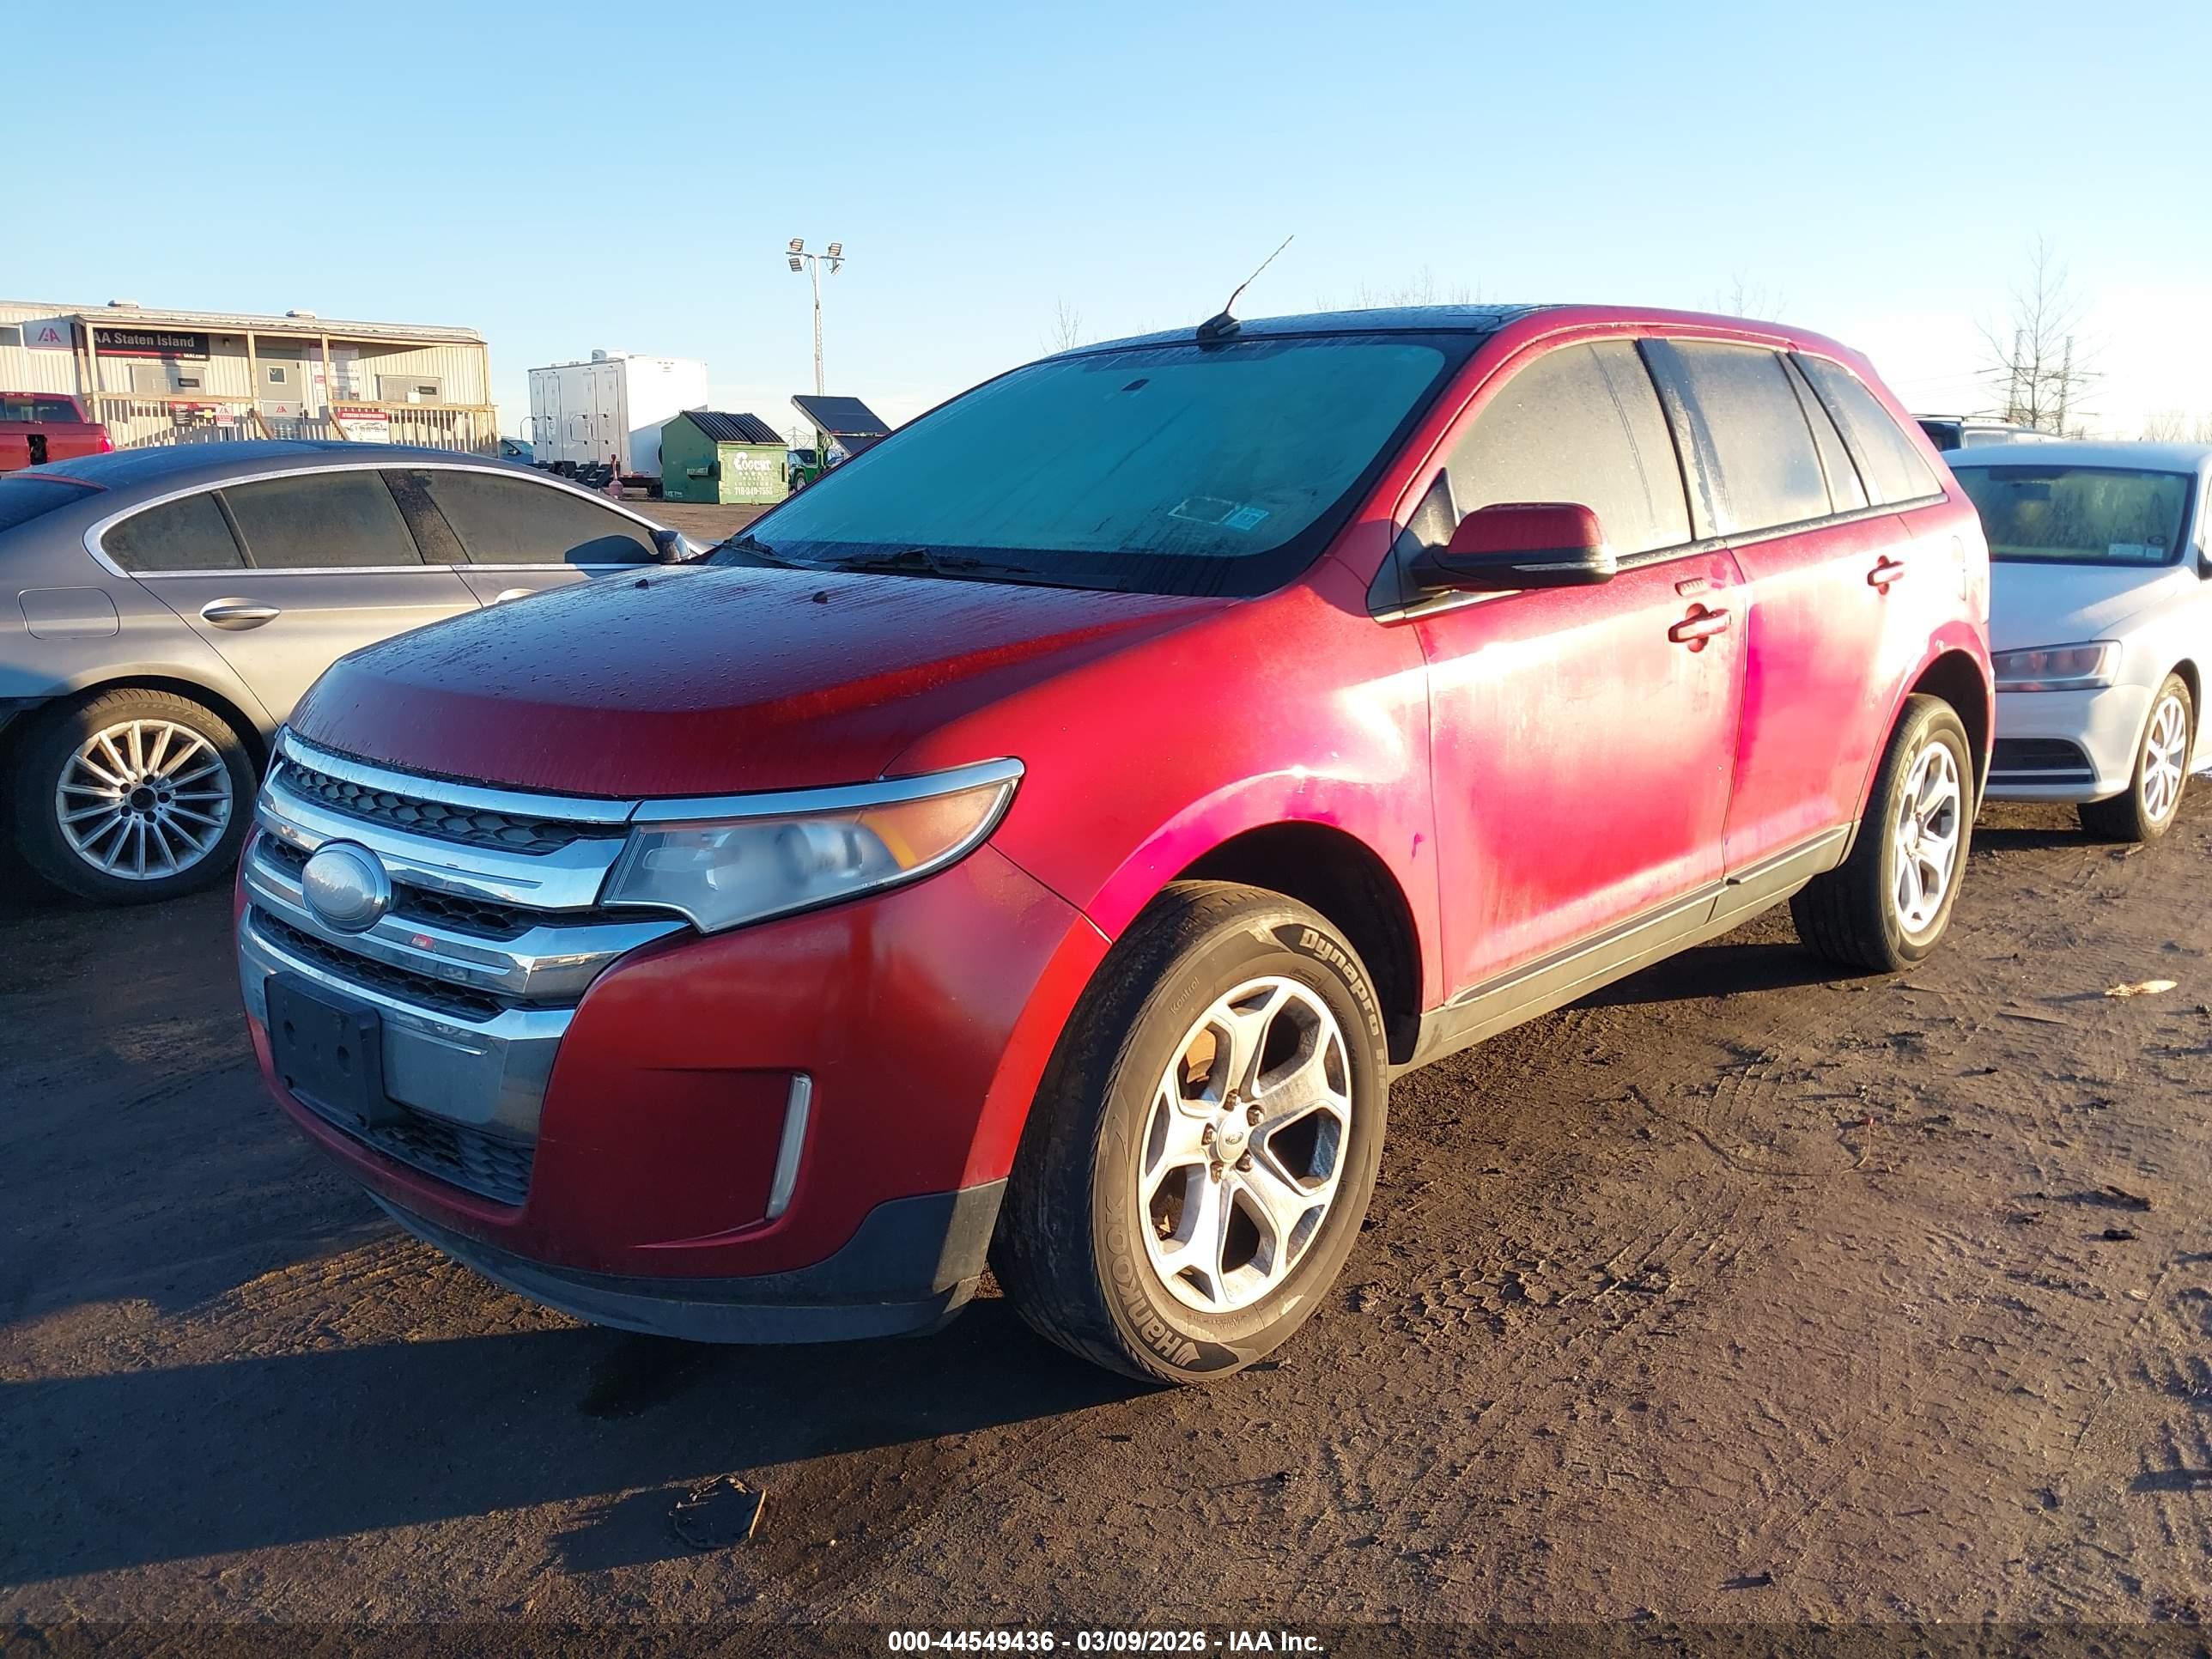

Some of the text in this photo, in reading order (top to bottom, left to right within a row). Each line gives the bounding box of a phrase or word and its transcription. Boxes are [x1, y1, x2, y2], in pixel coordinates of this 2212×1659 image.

[114, 331, 154, 345] Staten
[157, 335, 195, 348] Island
[1298, 927, 1380, 1036] Dynapro
